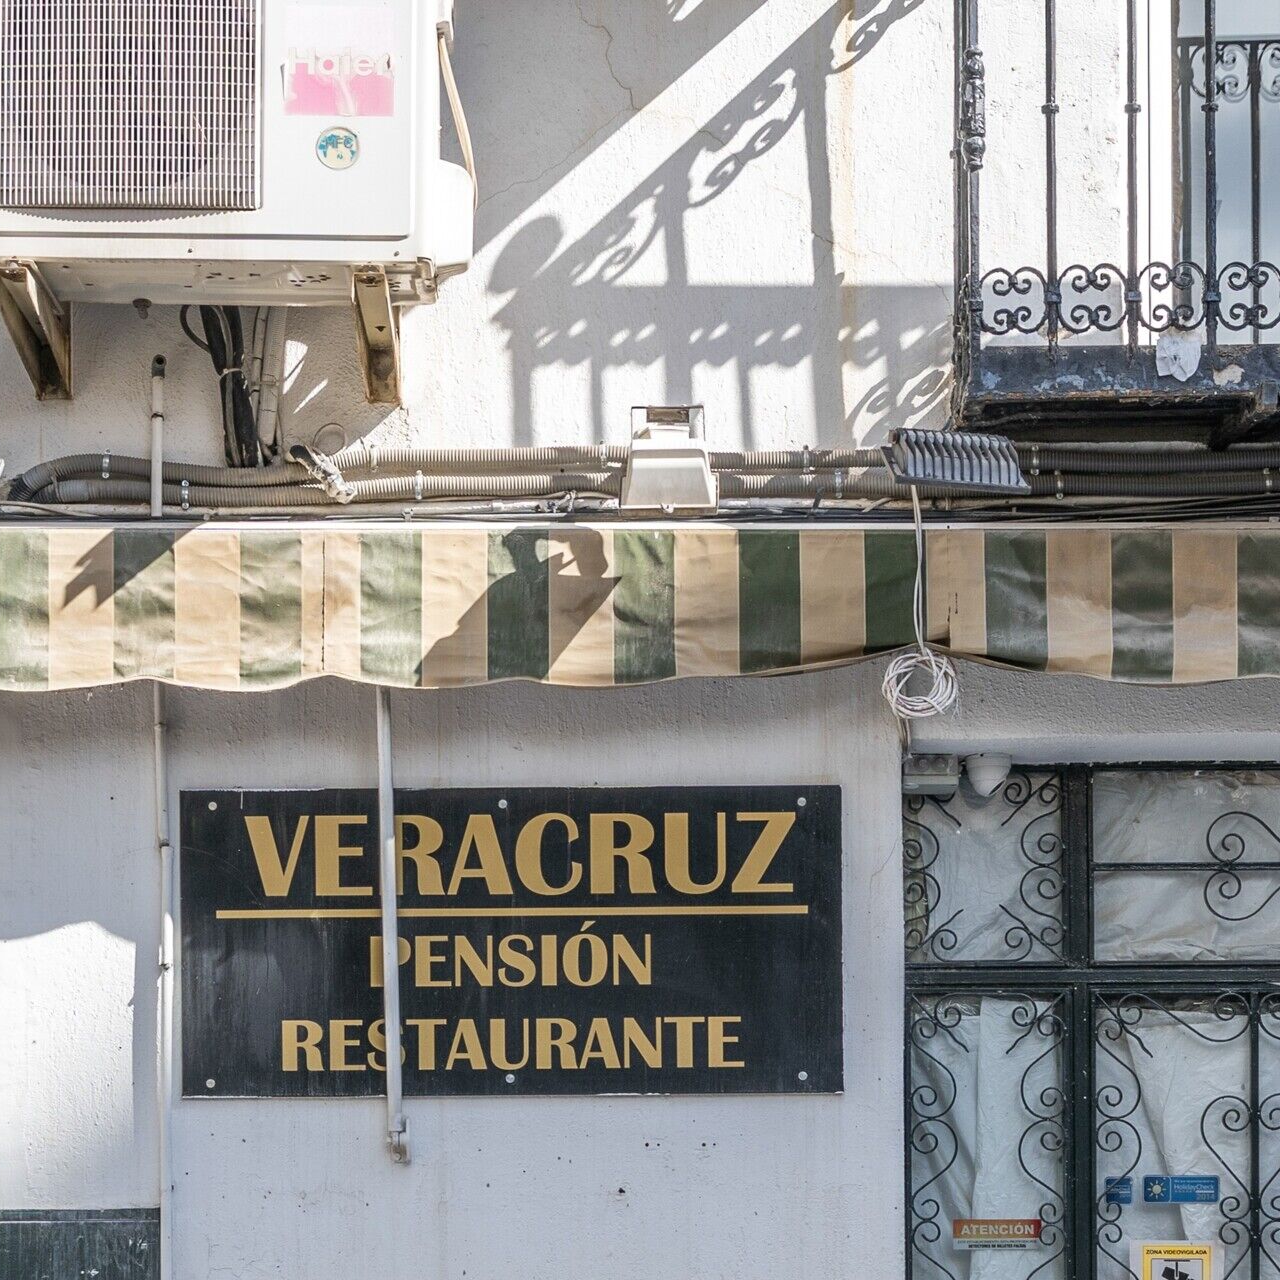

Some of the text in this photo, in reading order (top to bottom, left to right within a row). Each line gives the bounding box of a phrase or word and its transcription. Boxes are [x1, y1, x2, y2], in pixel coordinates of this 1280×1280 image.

[243, 811, 797, 898] VERACRUZ
[369, 920, 653, 989] PENSIÓN
[280, 1015, 746, 1073] RESTAURANTE
[961, 1222, 1035, 1235] ATENCIÓN
